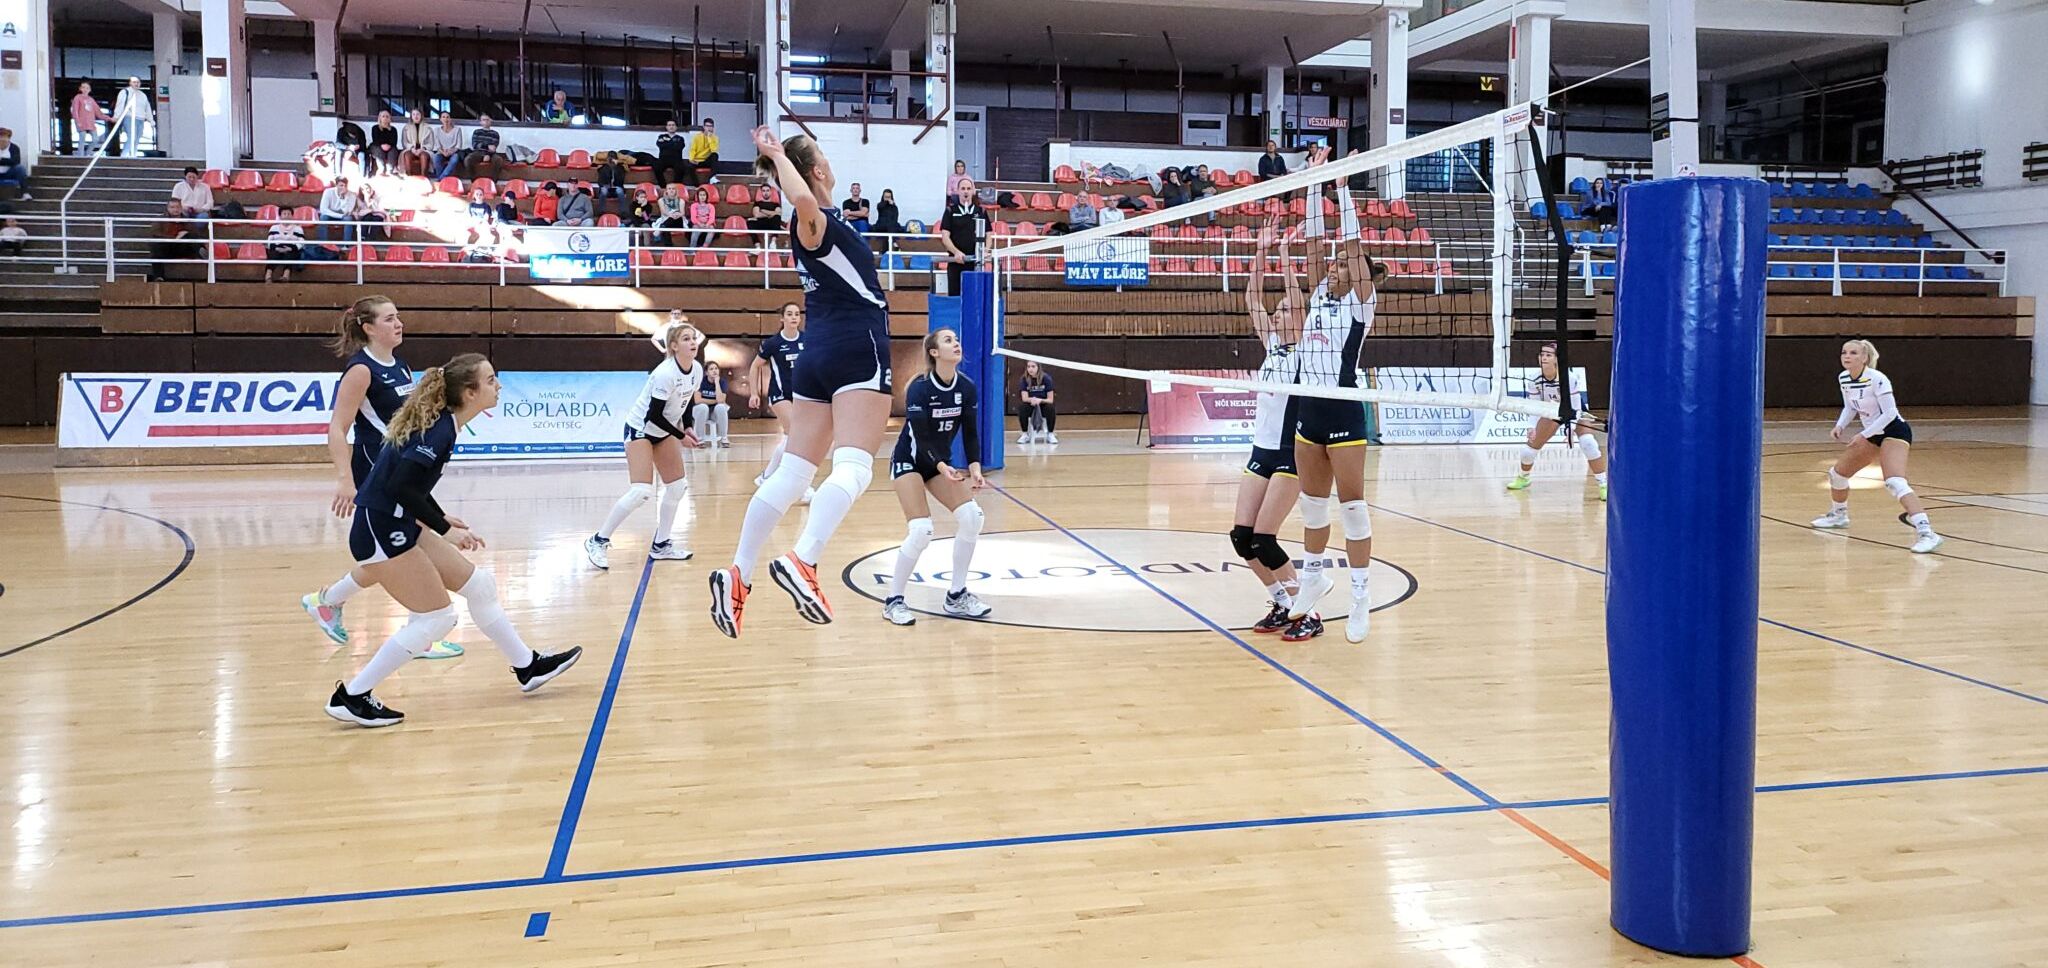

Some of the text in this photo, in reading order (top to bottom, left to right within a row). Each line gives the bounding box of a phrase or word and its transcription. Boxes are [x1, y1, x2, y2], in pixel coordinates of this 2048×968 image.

[1067, 264, 1147, 280] MÁV ELŐRE
[100, 385, 124, 413] B
[154, 380, 340, 413] BERICA
[538, 392, 576, 400] MAGYAR
[503, 399, 611, 418] RÖPLABDA
[1230, 399, 1257, 408] NEMZE
[1385, 407, 1471, 420] DELTAWELD
[1494, 412, 1530, 423] CSAR
[937, 420, 954, 432] 15
[389, 531, 407, 547] 3
